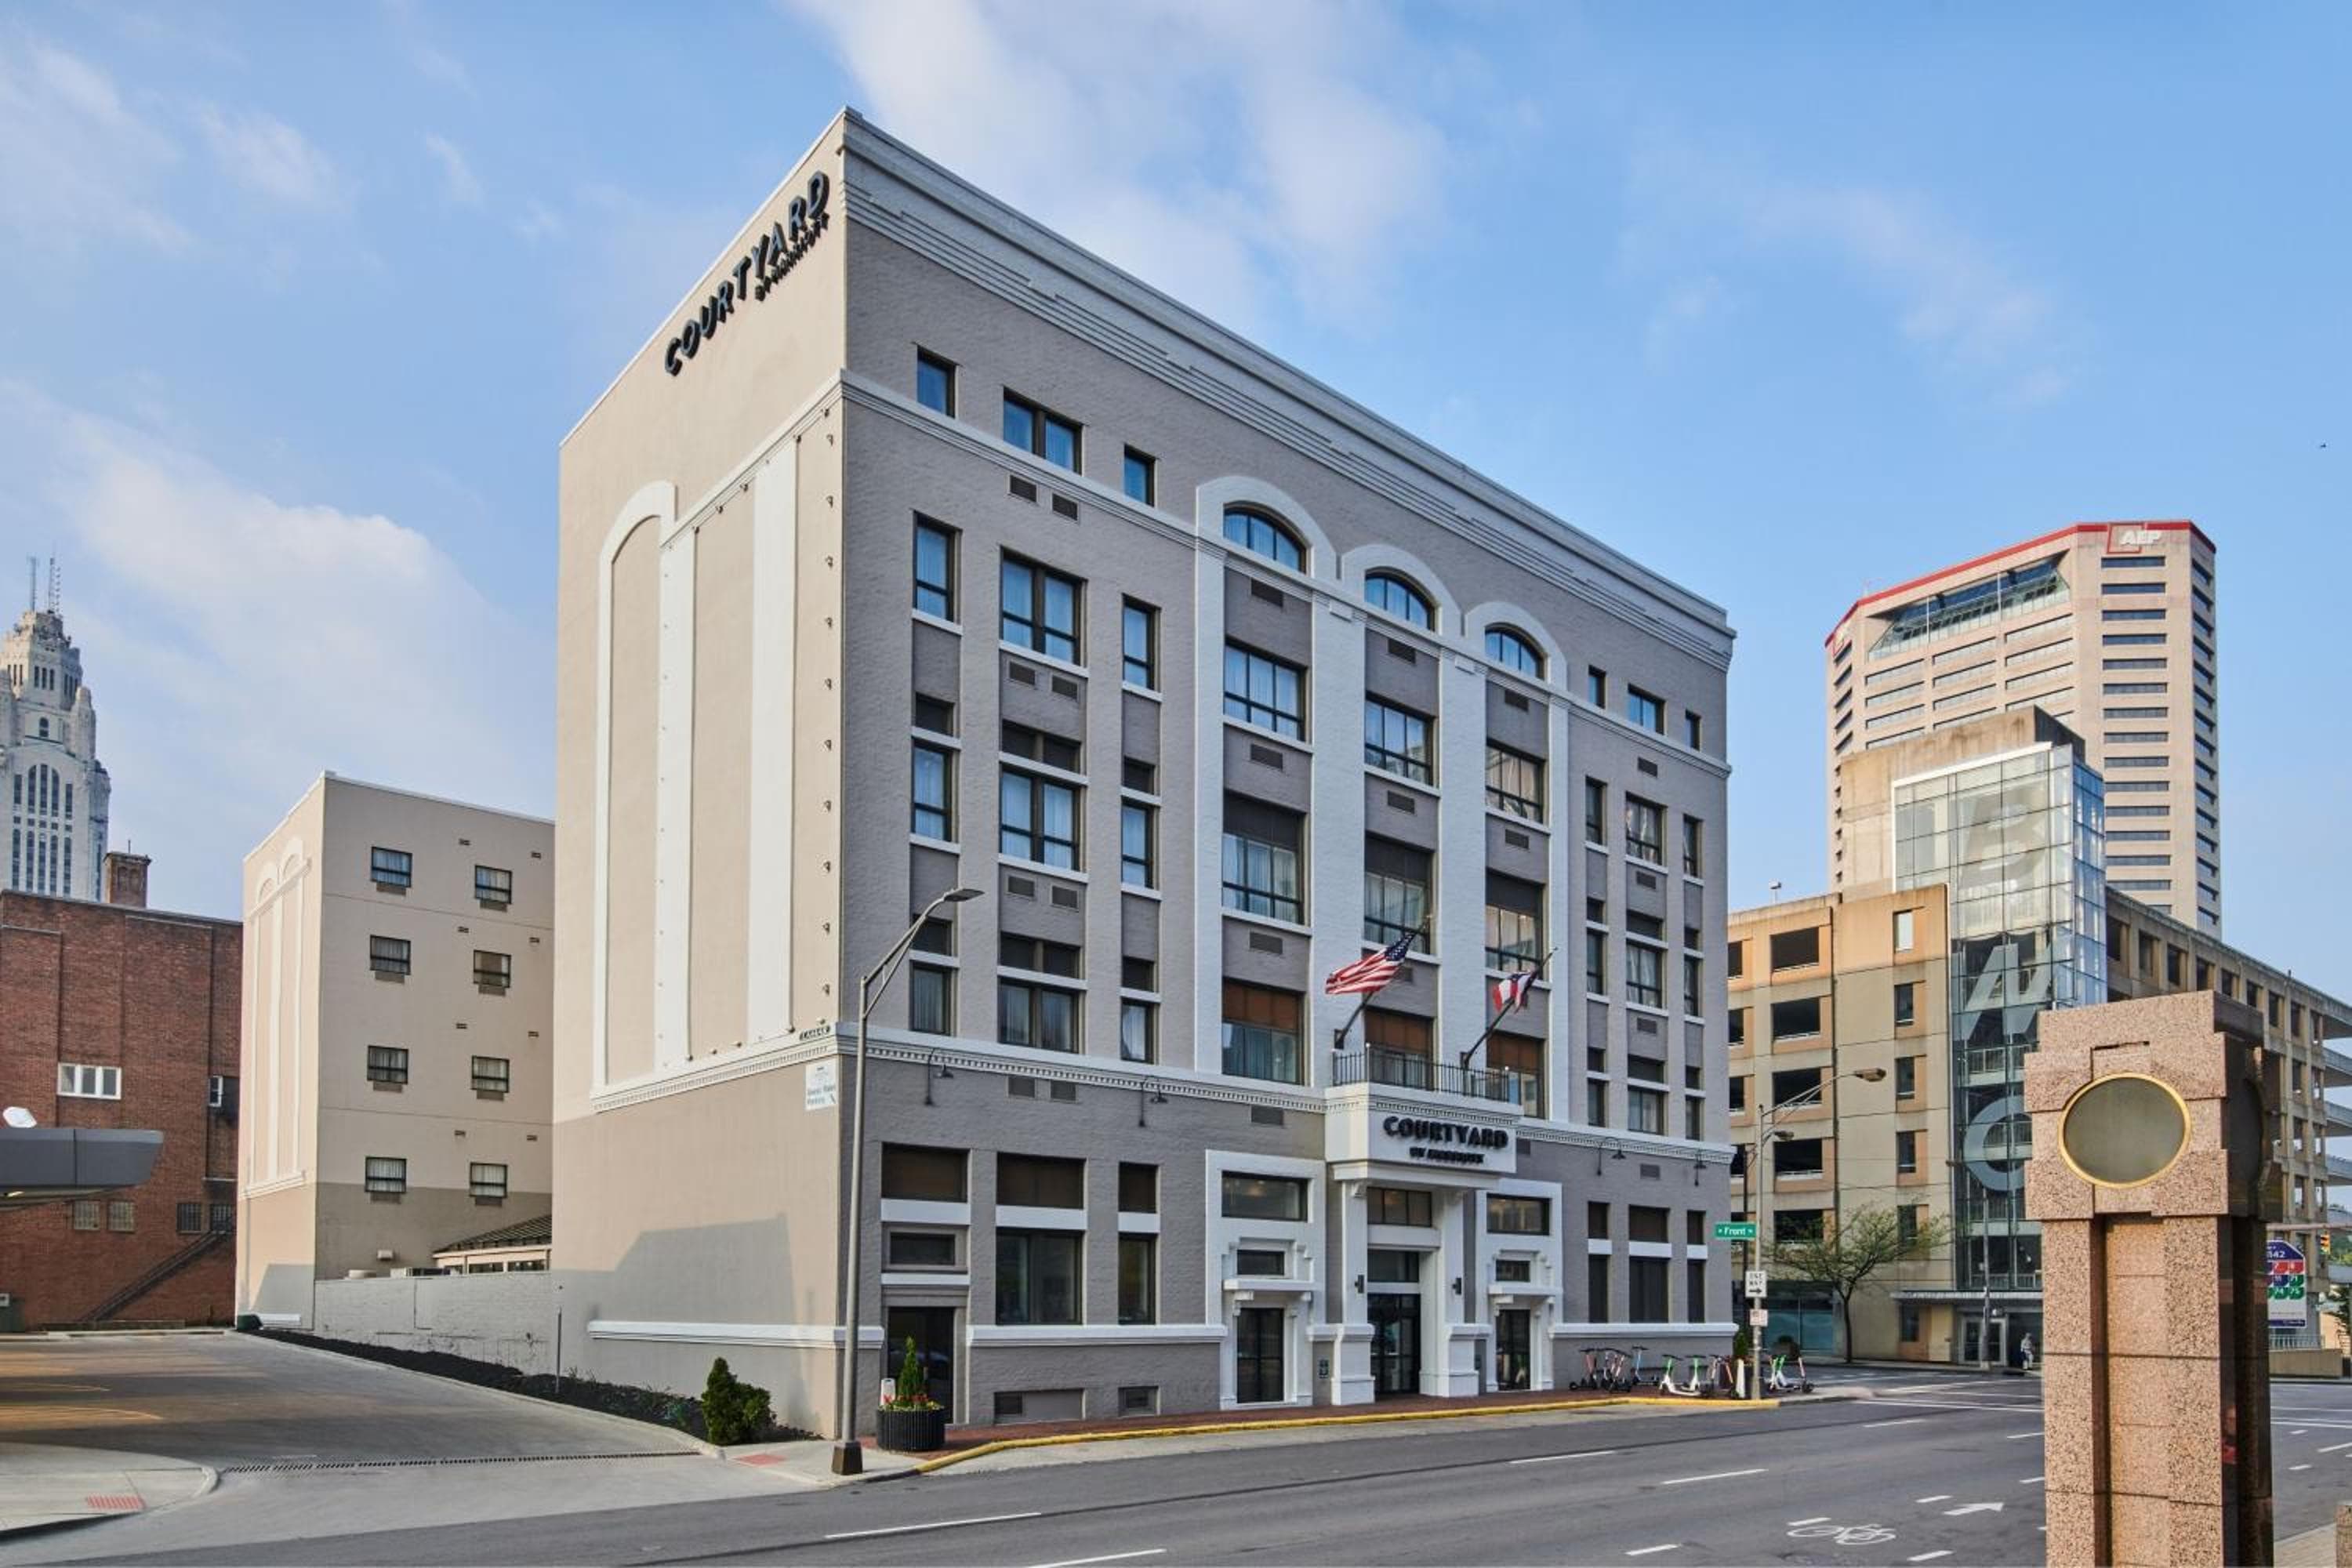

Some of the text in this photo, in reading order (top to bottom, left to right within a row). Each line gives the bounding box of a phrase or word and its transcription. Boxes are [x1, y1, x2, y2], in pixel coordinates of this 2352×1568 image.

[665, 170, 829, 376] COURTYARD
[1383, 1116, 1508, 1149] COURTYARD
[1723, 1226, 1745, 1236] Front
